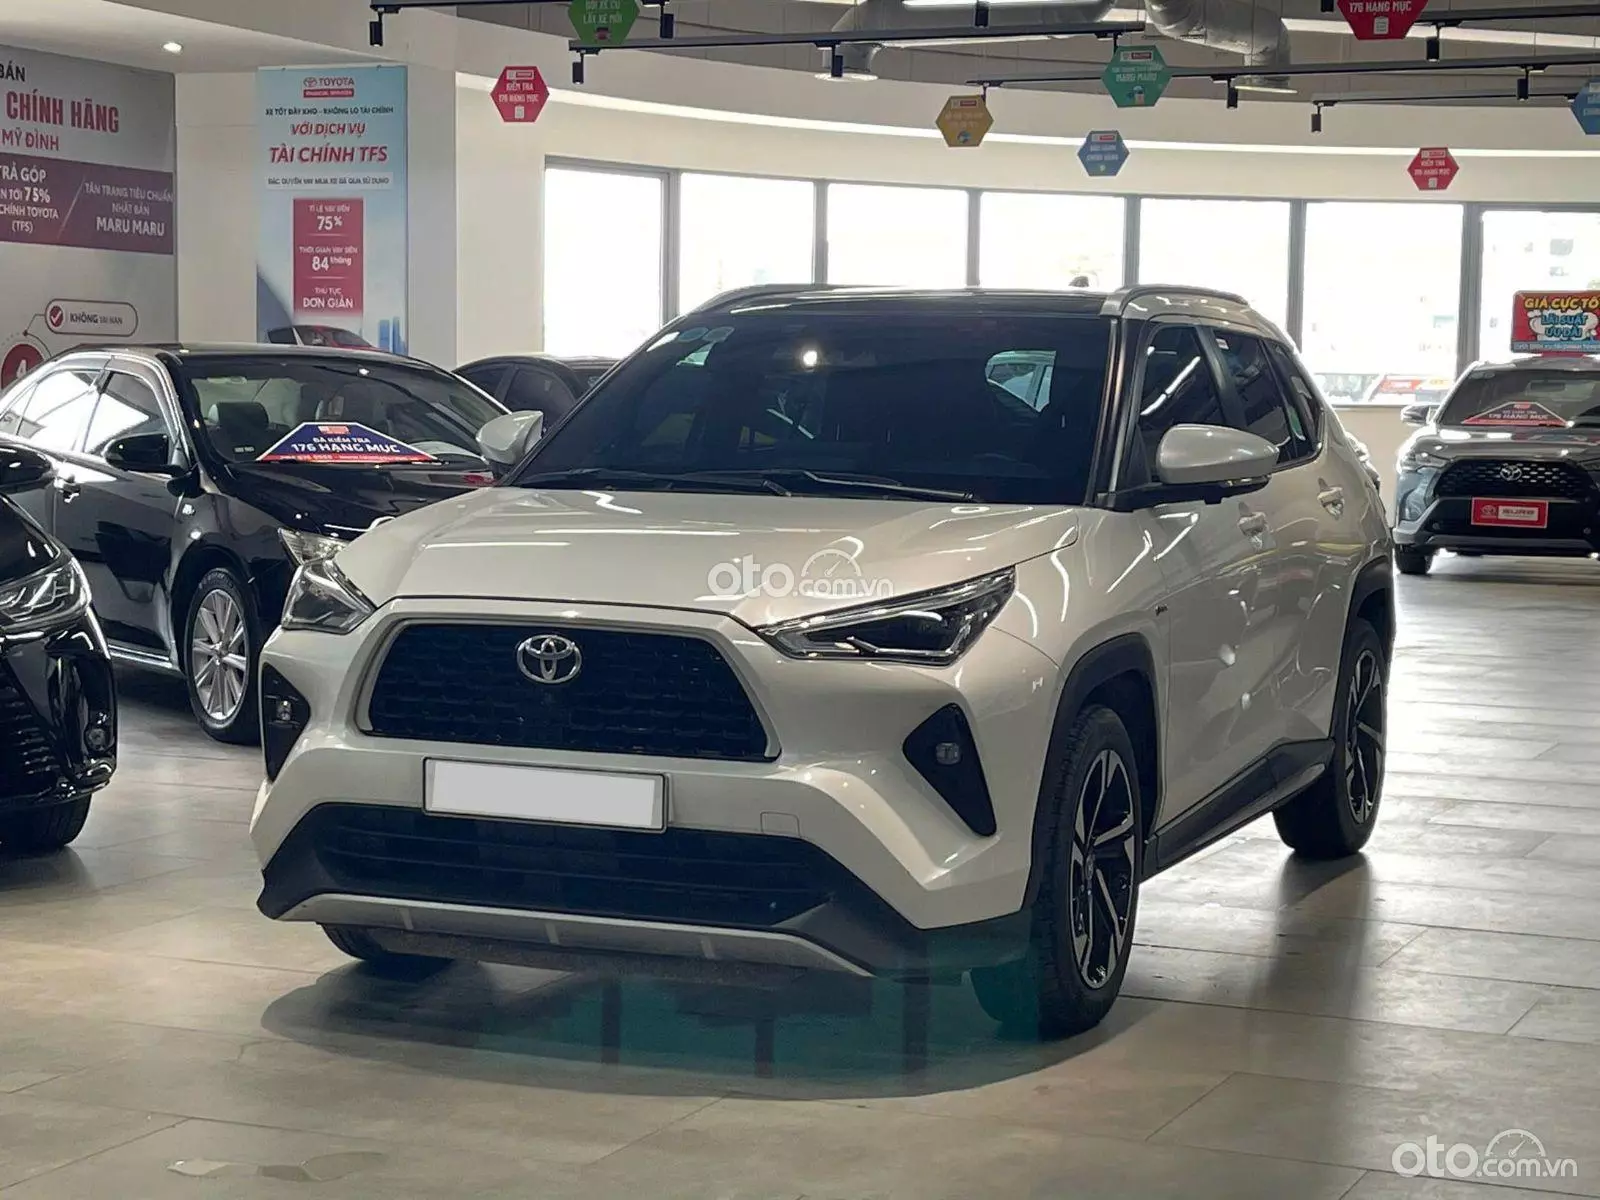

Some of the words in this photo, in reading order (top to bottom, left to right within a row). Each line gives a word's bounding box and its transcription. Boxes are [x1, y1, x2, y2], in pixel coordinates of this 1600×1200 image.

[1349, 3, 1364, 12] 176
[319, 77, 354, 87] TOYOTA
[6, 89, 63, 126] CHÍNH
[71, 98, 119, 133] HÃNG
[315, 123, 346, 138] DỊCH
[349, 123, 366, 138] VỤ
[2, 127, 22, 147] MỸ
[25, 130, 60, 151] ĐÌNH
[270, 142, 295, 162] TÀI
[298, 142, 354, 162] CHÍNH
[359, 146, 388, 162] TFS
[0, 161, 18, 180] RẢ
[21, 165, 46, 183] GÓP
[24, 187, 51, 203] 75%
[27, 206, 60, 219] TOYOTA
[96, 216, 131, 233] MARU
[132, 220, 165, 236] MARU
[317, 216, 343, 231] 75%
[312, 256, 330, 271] 84
[1524, 295, 1548, 309] GIÁ
[1550, 296, 1580, 311] CỰC
[70, 311, 98, 324] KHÔNG
[291, 443, 316, 452] 176
